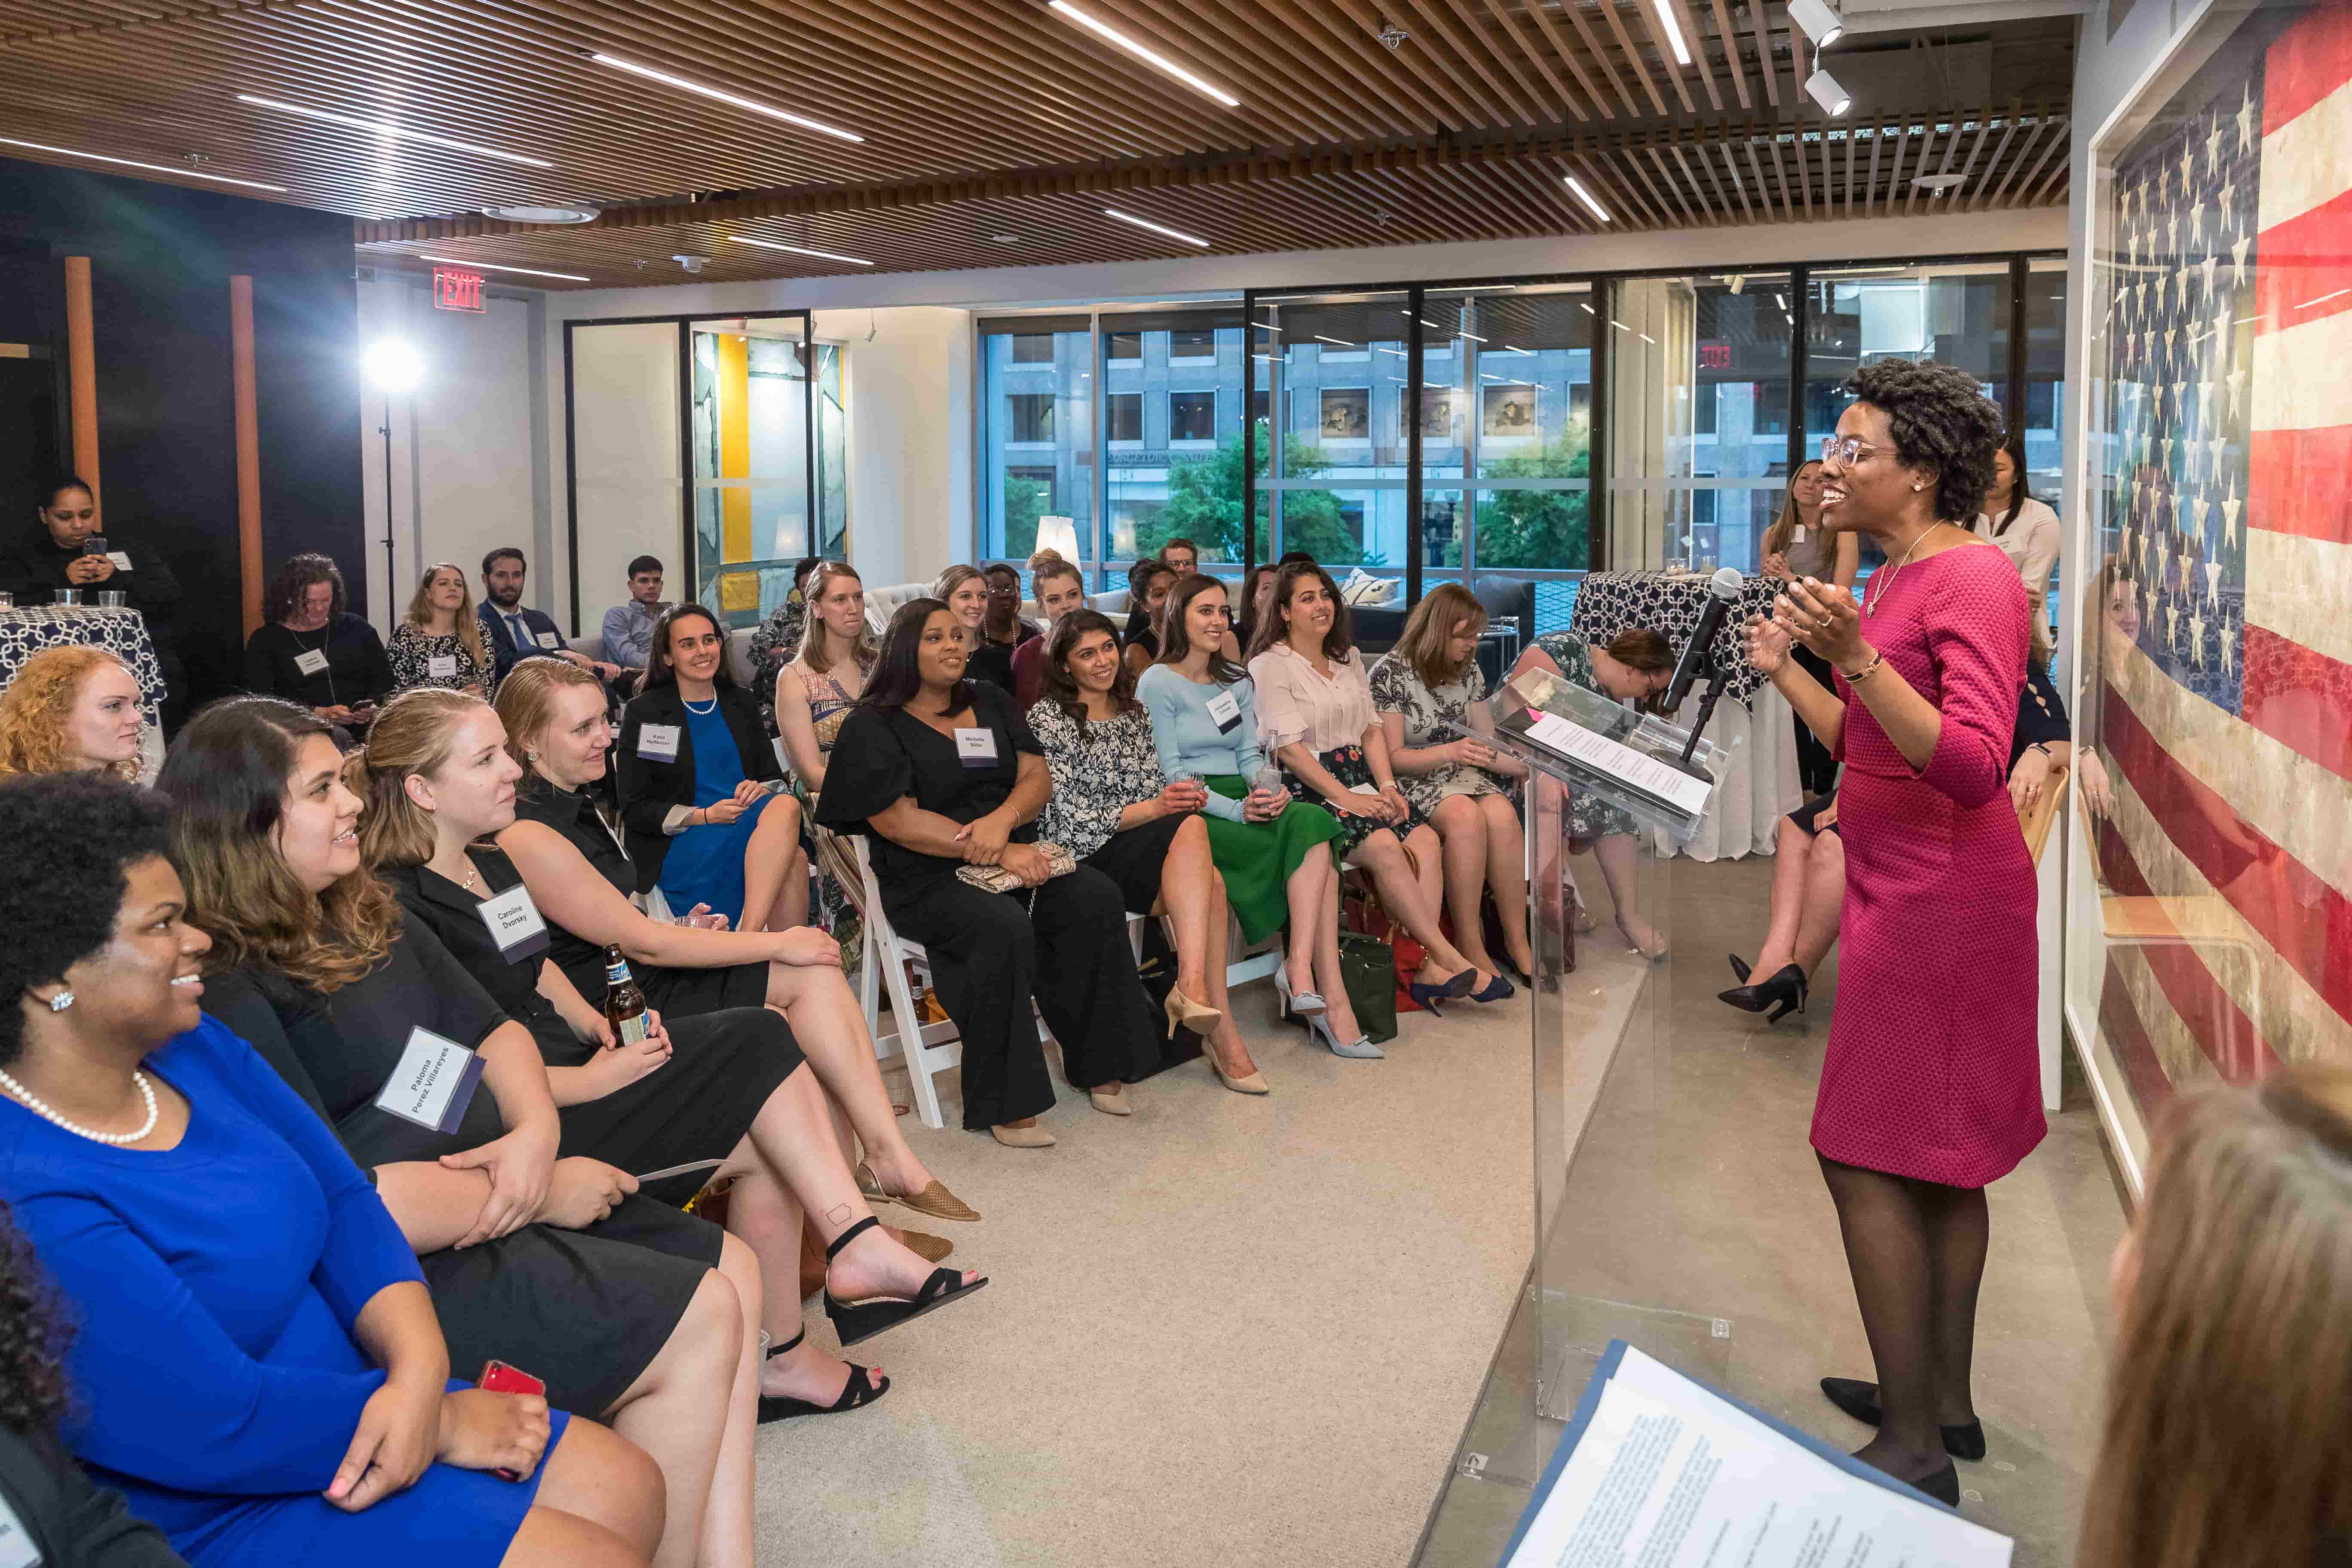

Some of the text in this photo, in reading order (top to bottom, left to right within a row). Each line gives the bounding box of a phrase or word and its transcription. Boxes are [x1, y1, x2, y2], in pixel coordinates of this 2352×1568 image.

[443, 272, 482, 309] EXIT
[498, 905, 523, 920] Caroline
[502, 914, 527, 929] Dvorsky
[411, 1059, 432, 1091] Paloma
[412, 1047, 449, 1114] Perez Villareyes
